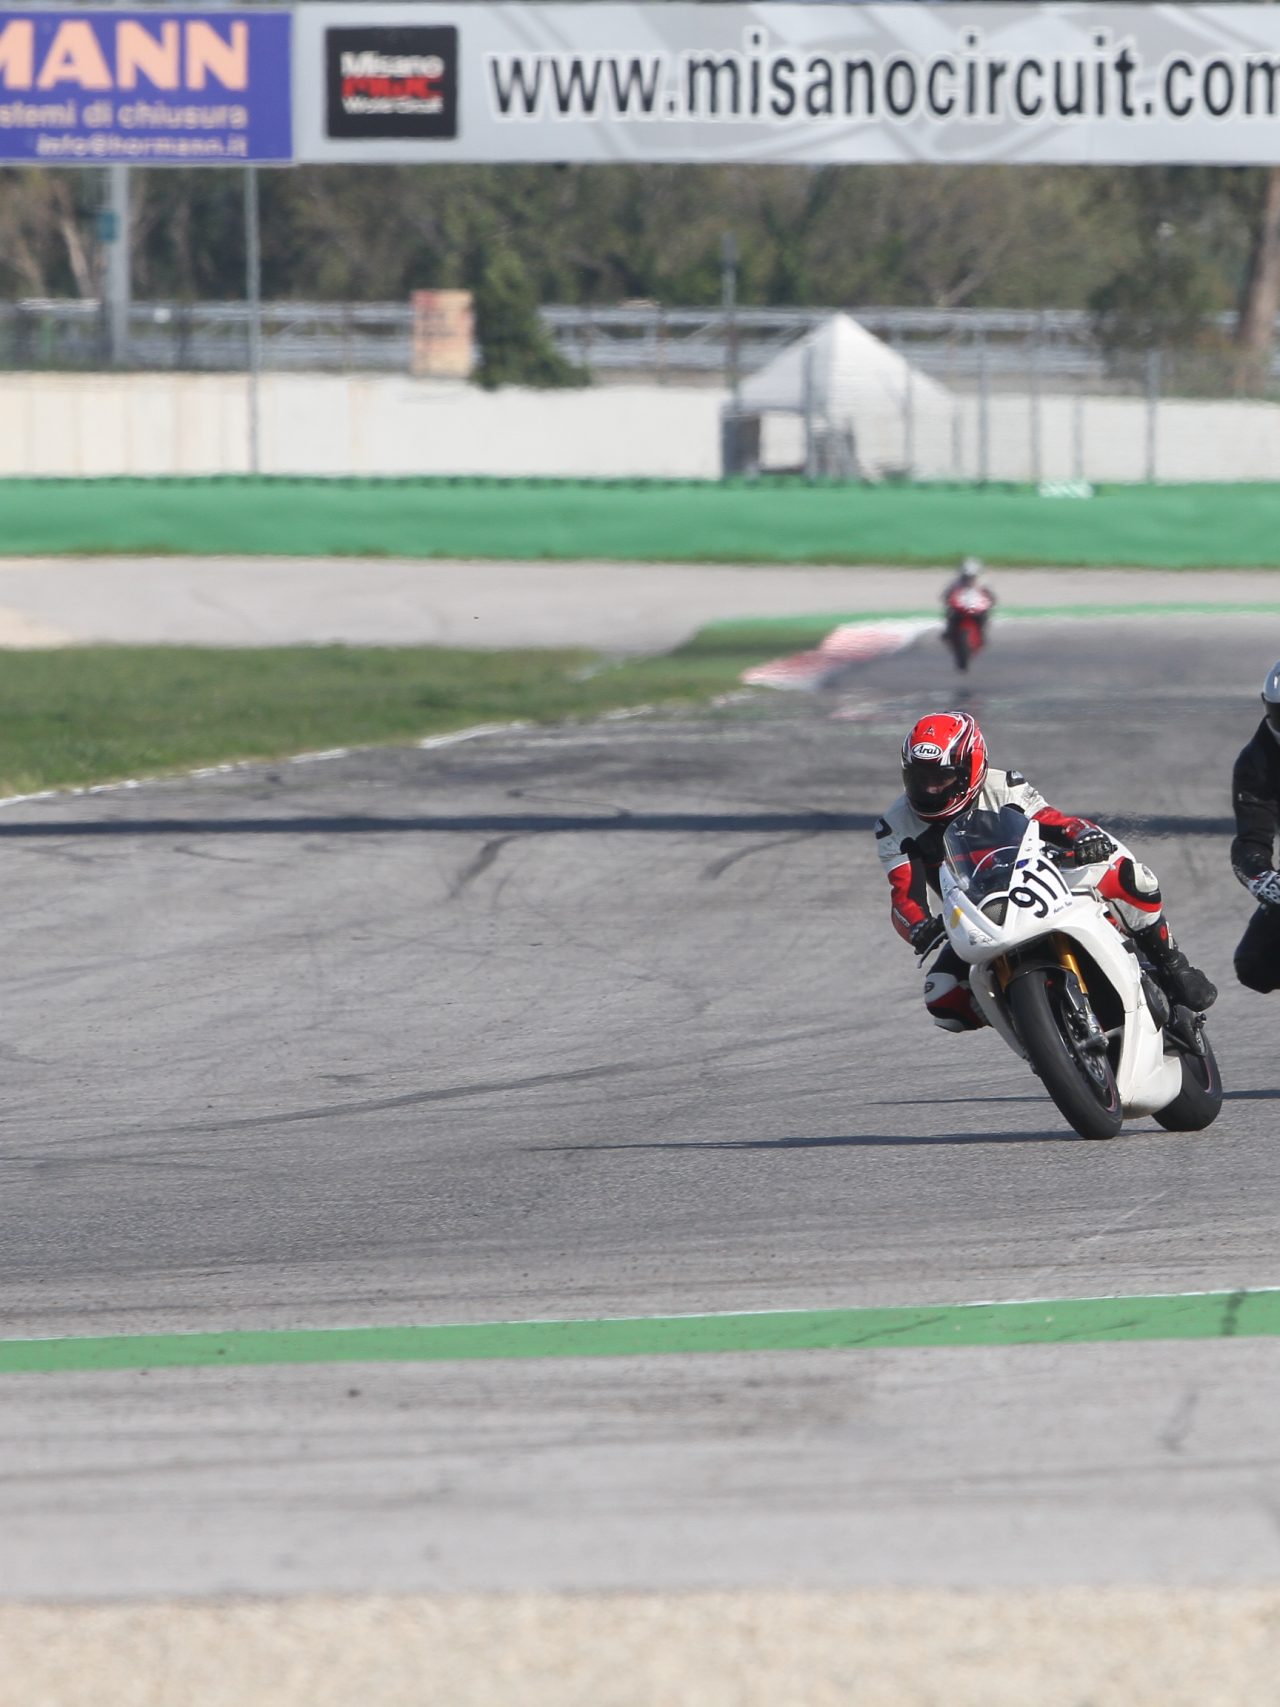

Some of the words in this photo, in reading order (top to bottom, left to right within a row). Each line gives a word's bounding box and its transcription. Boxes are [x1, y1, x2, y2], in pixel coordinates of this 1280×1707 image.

[82, 101, 113, 129] di
[117, 102, 248, 129] chiusura
[37, 134, 248, 157] info@hormann.it
[913, 745, 938, 755] Arai
[1008, 858, 1069, 919] 911
